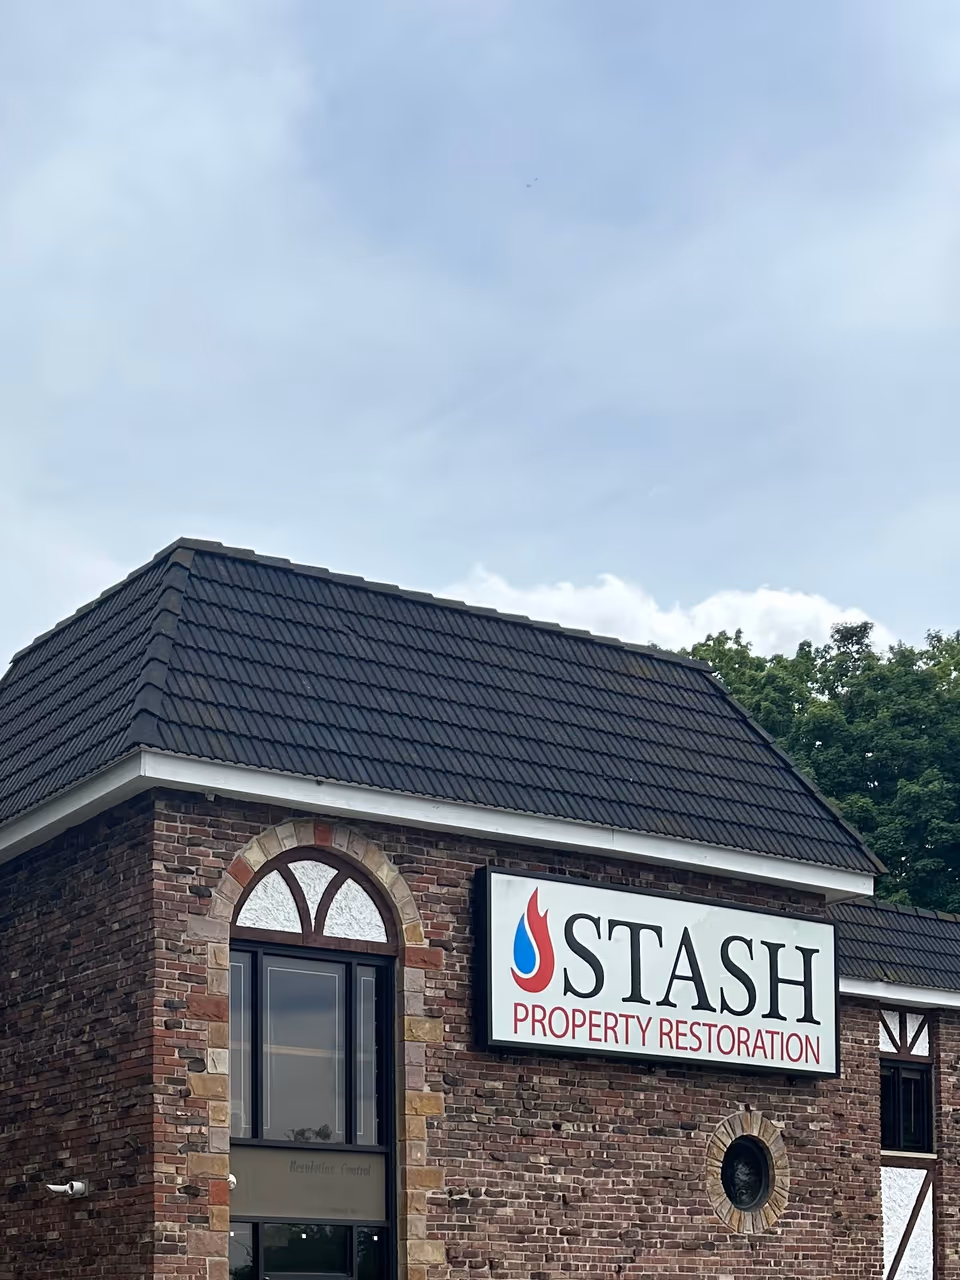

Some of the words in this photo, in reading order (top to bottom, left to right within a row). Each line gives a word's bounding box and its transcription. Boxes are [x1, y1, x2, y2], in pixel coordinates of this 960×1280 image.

[563, 913, 821, 1026] STASH
[513, 1002, 653, 1047] PROPERTY
[659, 1018, 820, 1065] RESTORATION
